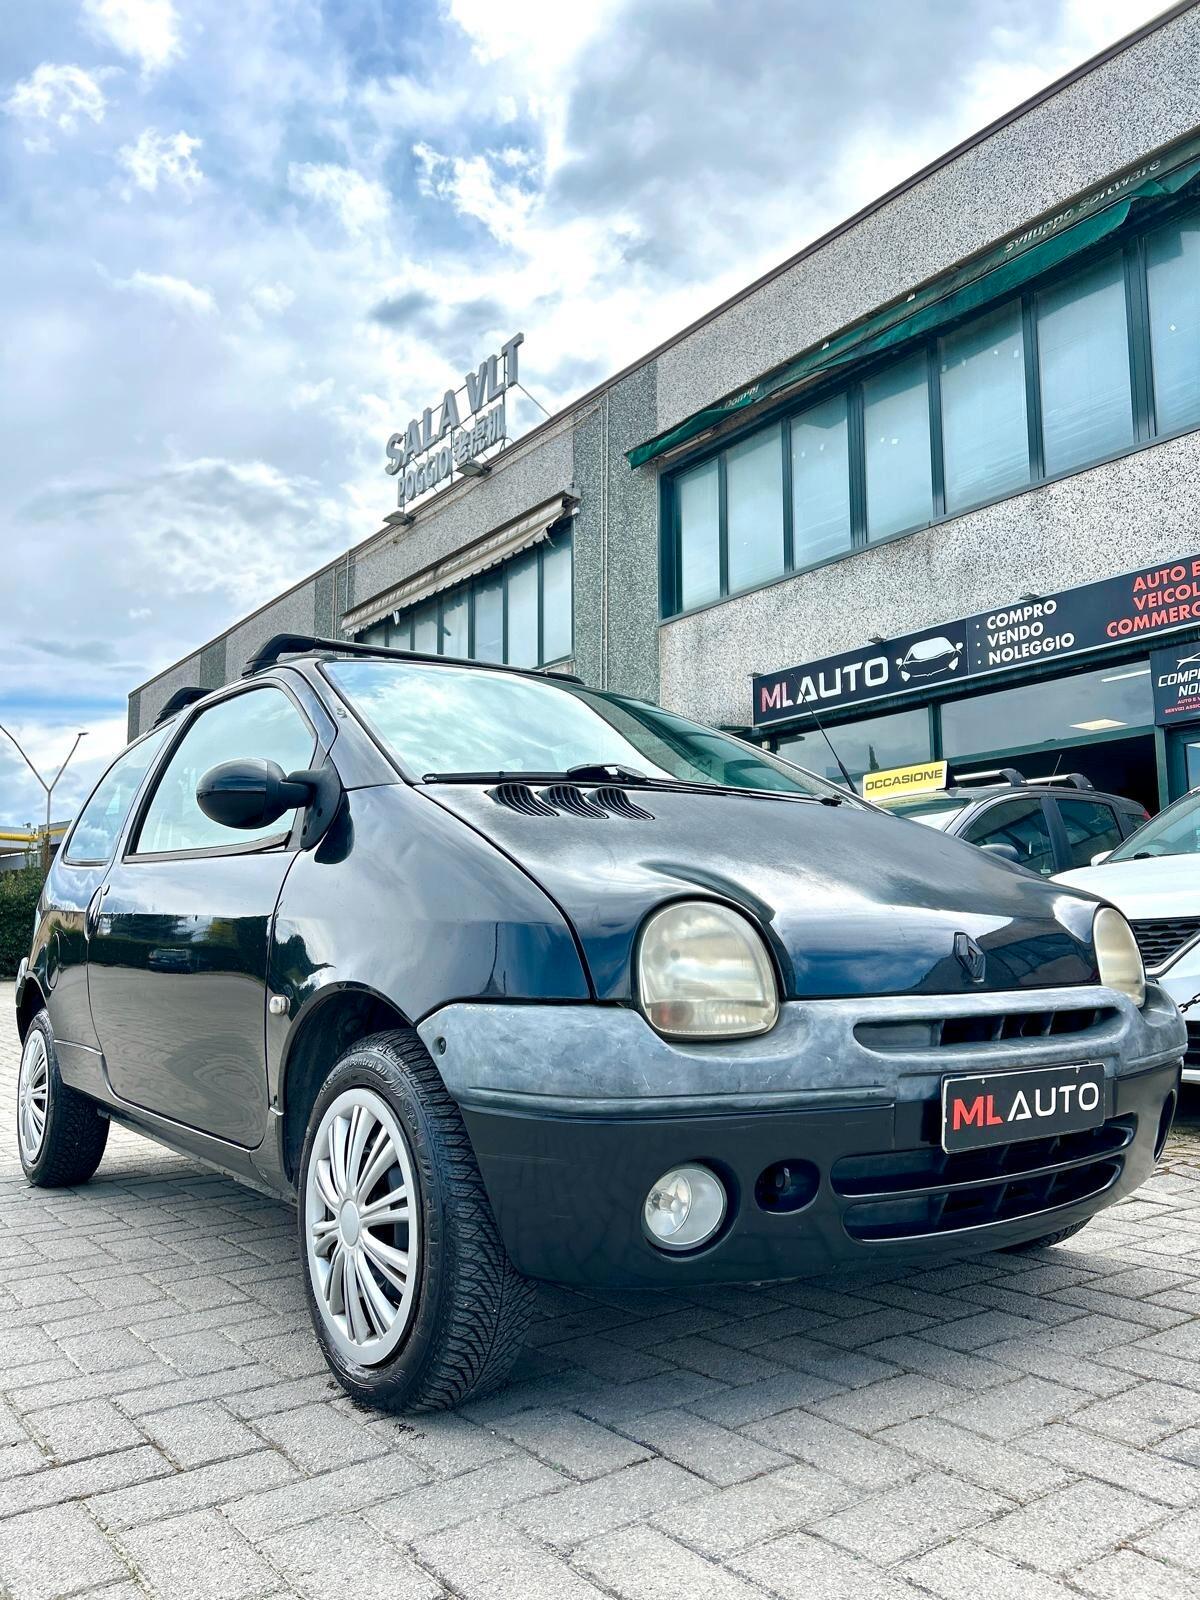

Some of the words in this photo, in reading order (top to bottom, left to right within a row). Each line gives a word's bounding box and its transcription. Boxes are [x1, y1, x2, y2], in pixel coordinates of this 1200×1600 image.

[385, 388, 460, 476] SALA
[465, 332, 524, 414] VLT
[397, 446, 452, 507] POGGIO
[1133, 565, 1186, 592] AUTO
[1133, 582, 1200, 611] VEICOL
[986, 600, 1057, 630] COMPRO
[987, 621, 1044, 648] VENDO
[988, 632, 1075, 666] NOLEGGIO
[1158, 668, 1200, 687] COMP
[1178, 683, 1200, 697] NO
[865, 769, 943, 791] OCCASIONE
